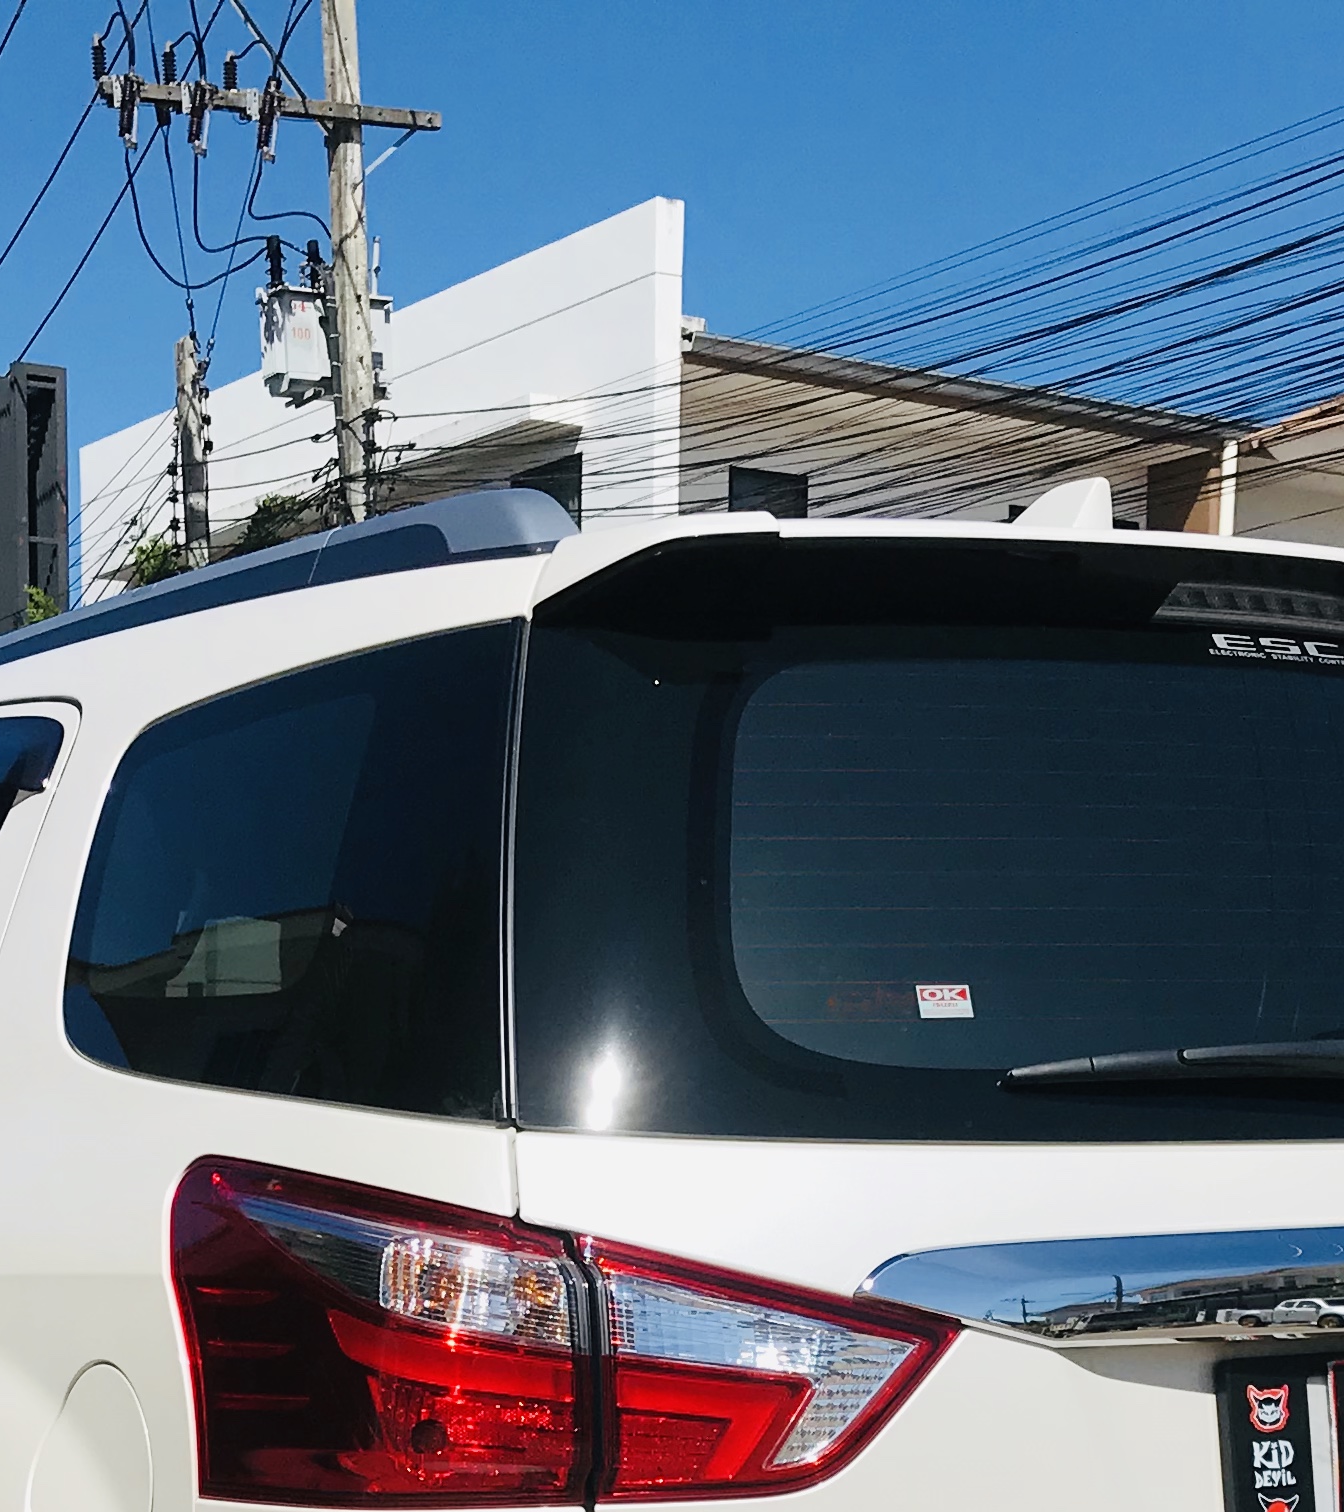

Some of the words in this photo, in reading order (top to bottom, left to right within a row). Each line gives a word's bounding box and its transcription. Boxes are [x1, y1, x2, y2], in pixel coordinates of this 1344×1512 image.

[1211, 633, 1344, 659] ESC
[1208, 648, 1267, 659] ELECTRONIC
[1270, 653, 1314, 663] STABILITY
[922, 988, 967, 1001] OK
